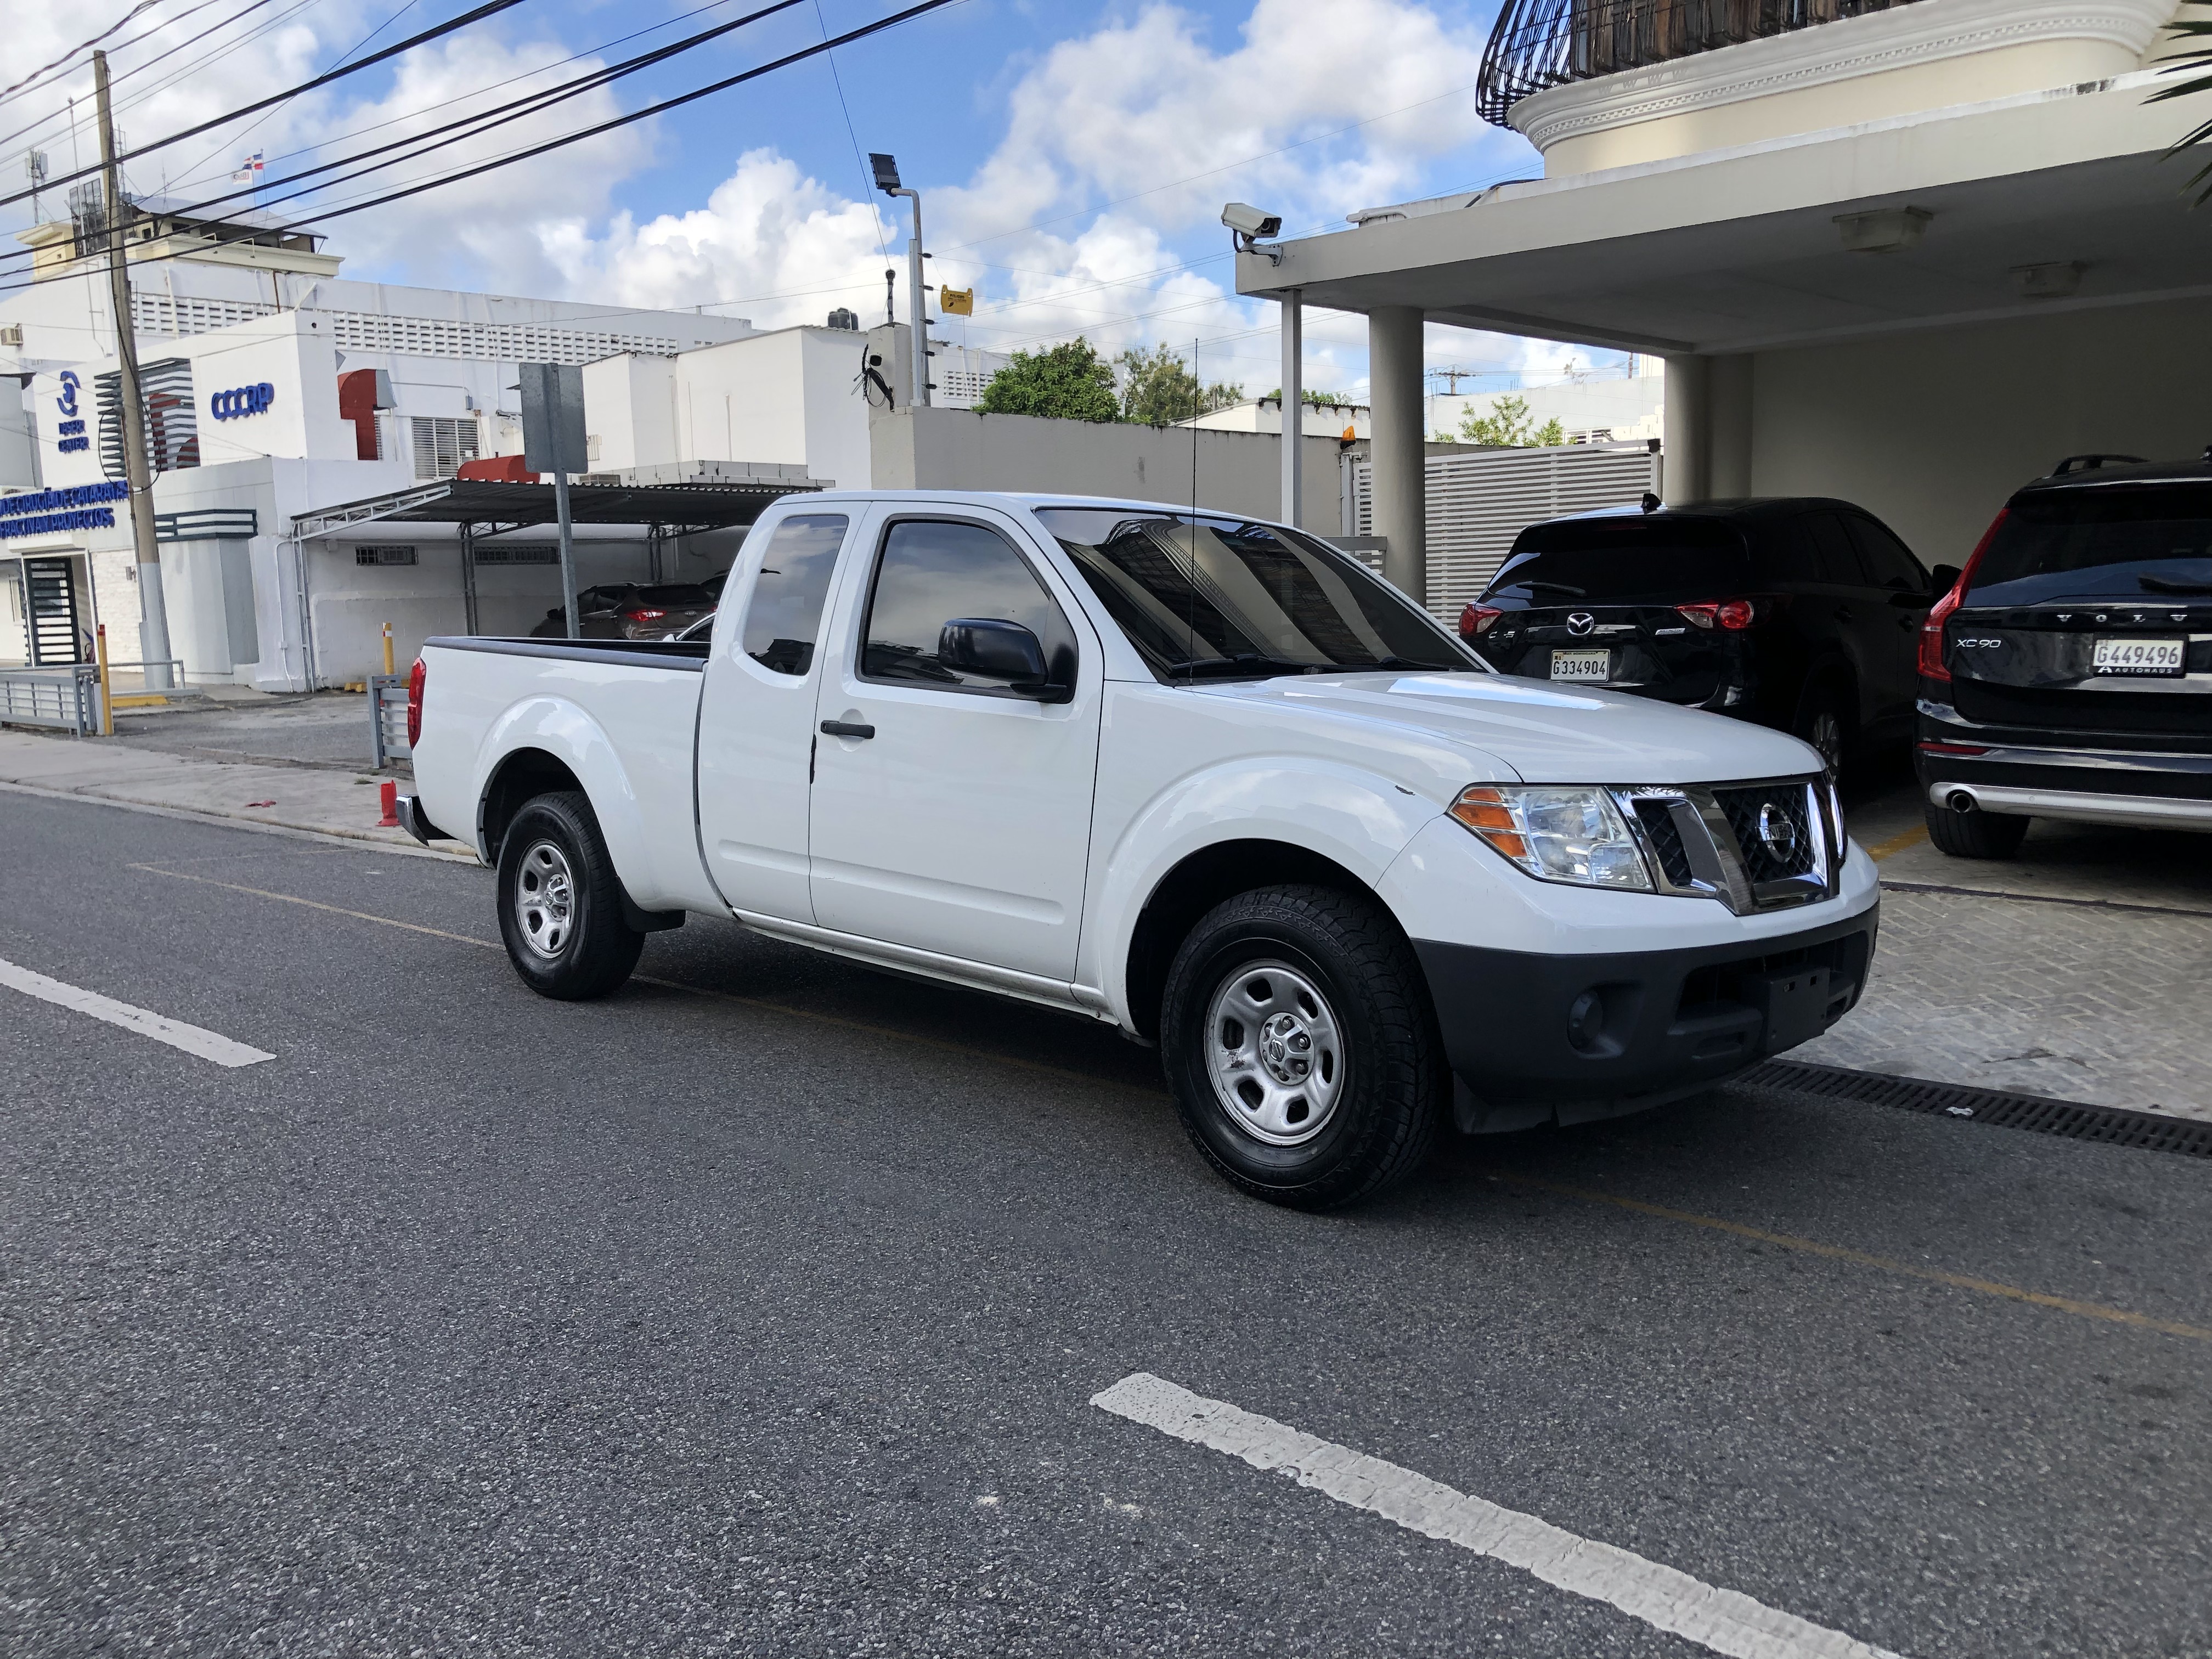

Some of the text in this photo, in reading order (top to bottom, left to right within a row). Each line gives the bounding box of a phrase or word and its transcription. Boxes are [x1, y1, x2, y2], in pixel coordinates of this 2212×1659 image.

[212, 383, 274, 421] CCCRP
[59, 420, 85, 435] LASER
[58, 437, 89, 453] CENTER
[3, 496, 17, 515] DE
[56, 488, 71, 509] DE
[71, 480, 128, 506] CATARATAS
[52, 507, 115, 533] PROYECTOS
[2097, 646, 2178, 665] G449496
[1553, 661, 1605, 675] G334904
